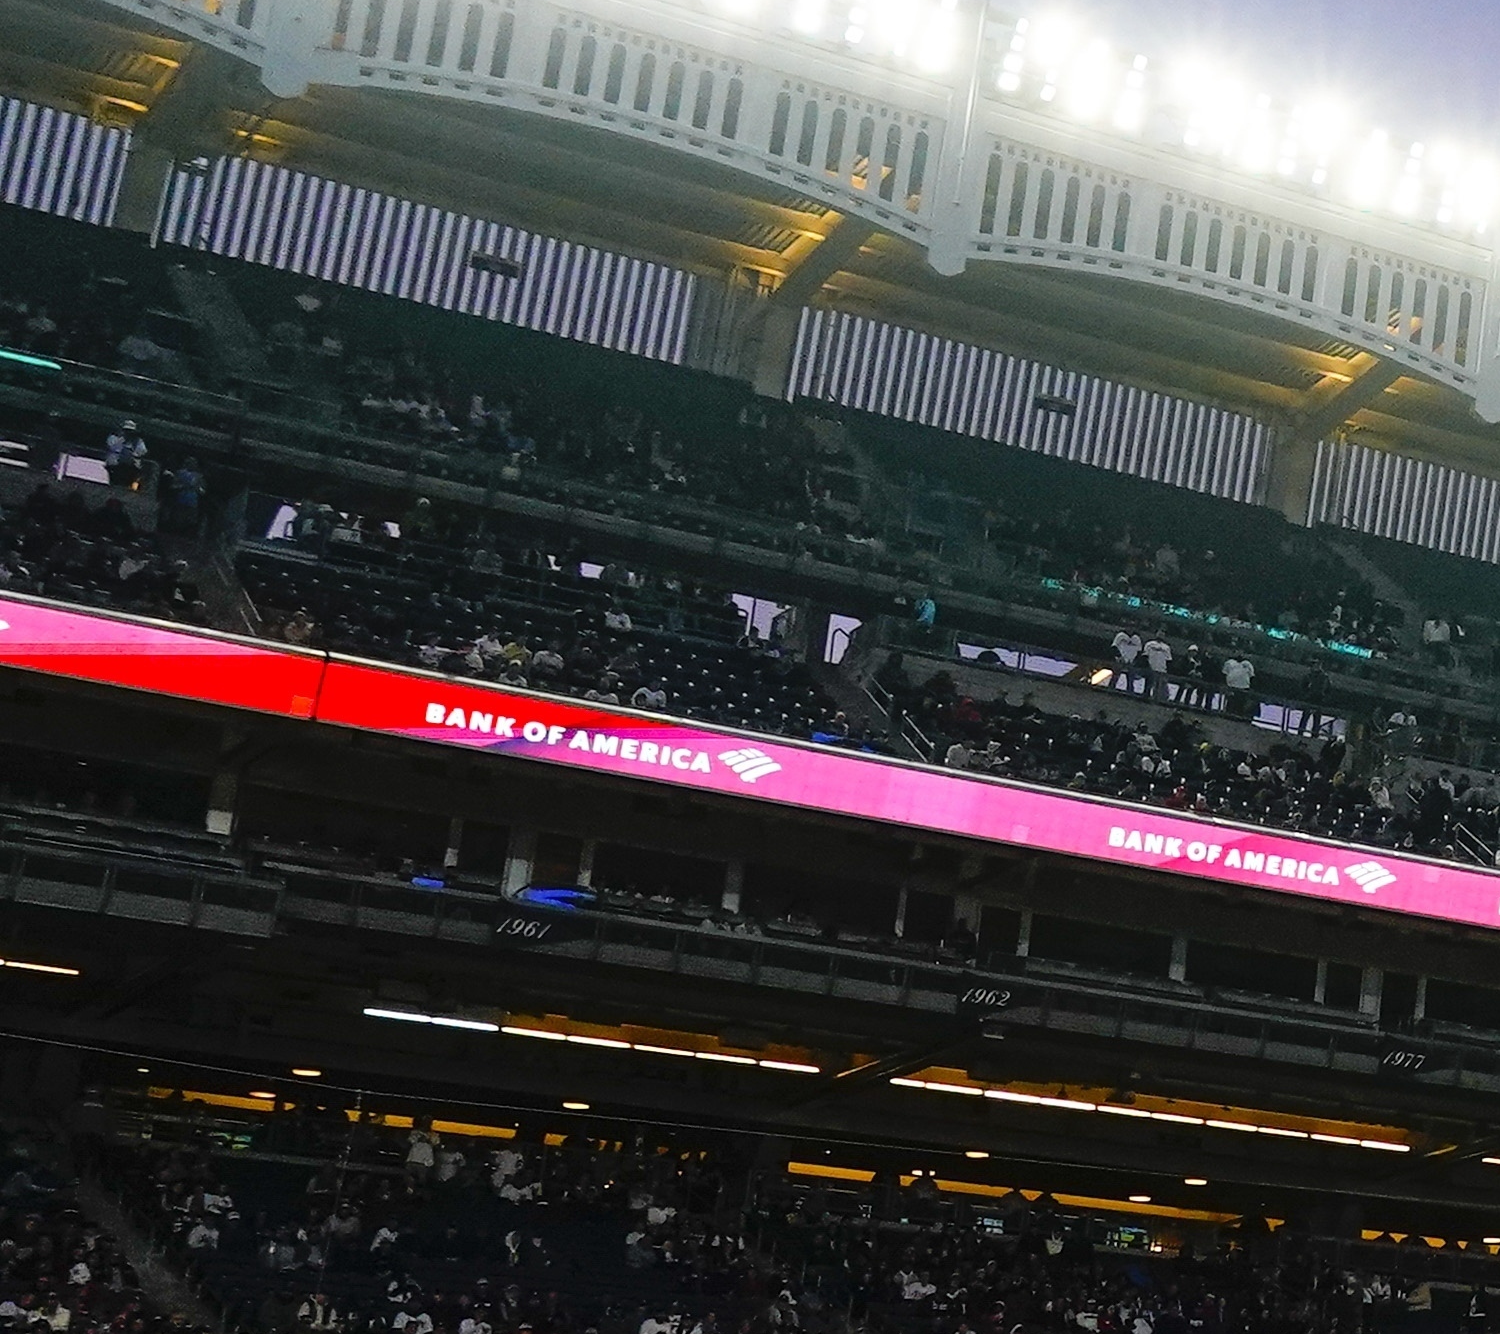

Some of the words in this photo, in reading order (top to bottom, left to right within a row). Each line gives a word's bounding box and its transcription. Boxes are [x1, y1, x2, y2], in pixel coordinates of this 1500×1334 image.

[425, 702, 516, 738] BANK
[523, 720, 566, 745] OF
[569, 730, 711, 773] AMERICA
[1108, 826, 1183, 858] BANK
[1187, 841, 1223, 864] OF
[1224, 848, 1339, 886] AMERICA
[496, 917, 552, 940] 1961
[961, 986, 1011, 1008] 1962
[1382, 1049, 1426, 1070] 1977
